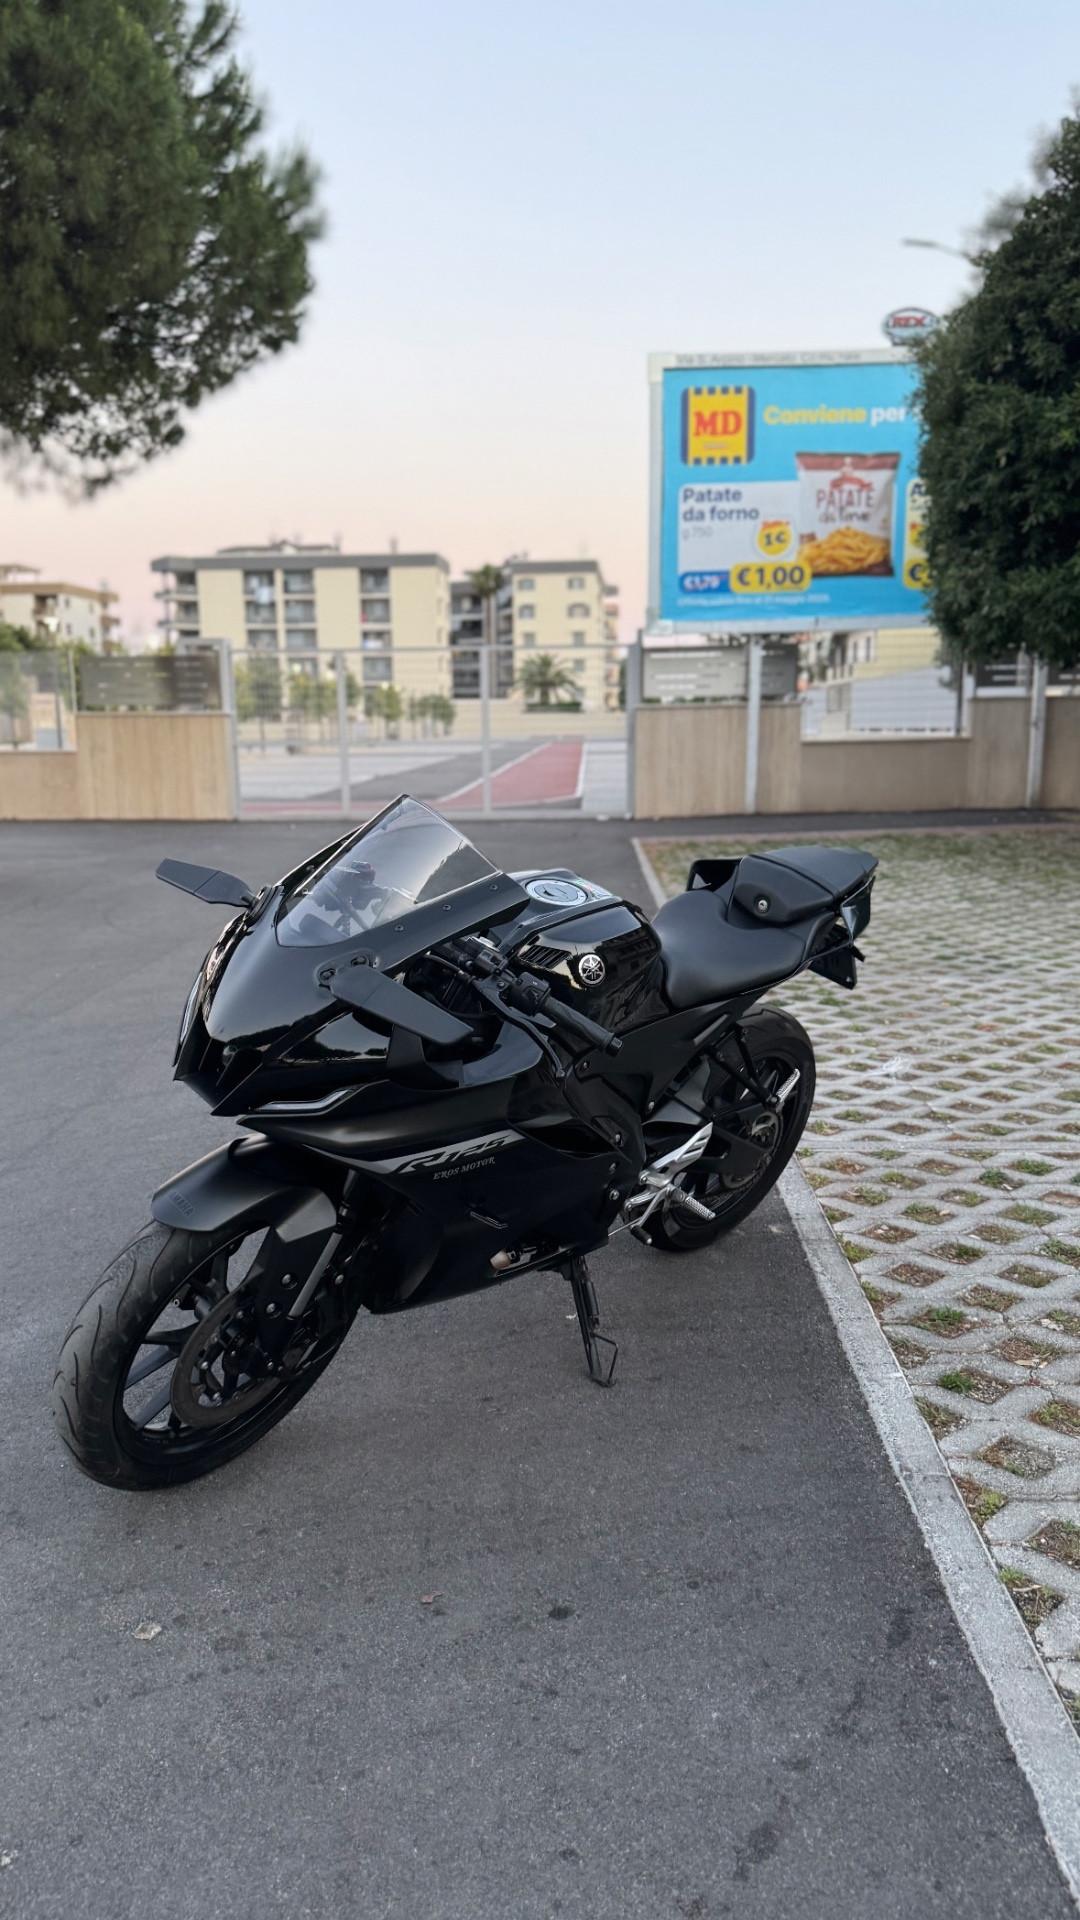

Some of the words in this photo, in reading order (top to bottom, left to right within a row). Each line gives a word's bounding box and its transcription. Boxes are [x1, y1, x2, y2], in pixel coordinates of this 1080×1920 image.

[892, 315, 927, 328] REX
[763, 405, 867, 425] Conviene
[693, 411, 742, 437] MD
[683, 488, 742, 503] Patate
[816, 488, 874, 508] PATATE
[683, 507, 705, 521] da
[710, 505, 760, 521] forno
[433, 1166, 461, 1180] EROS
